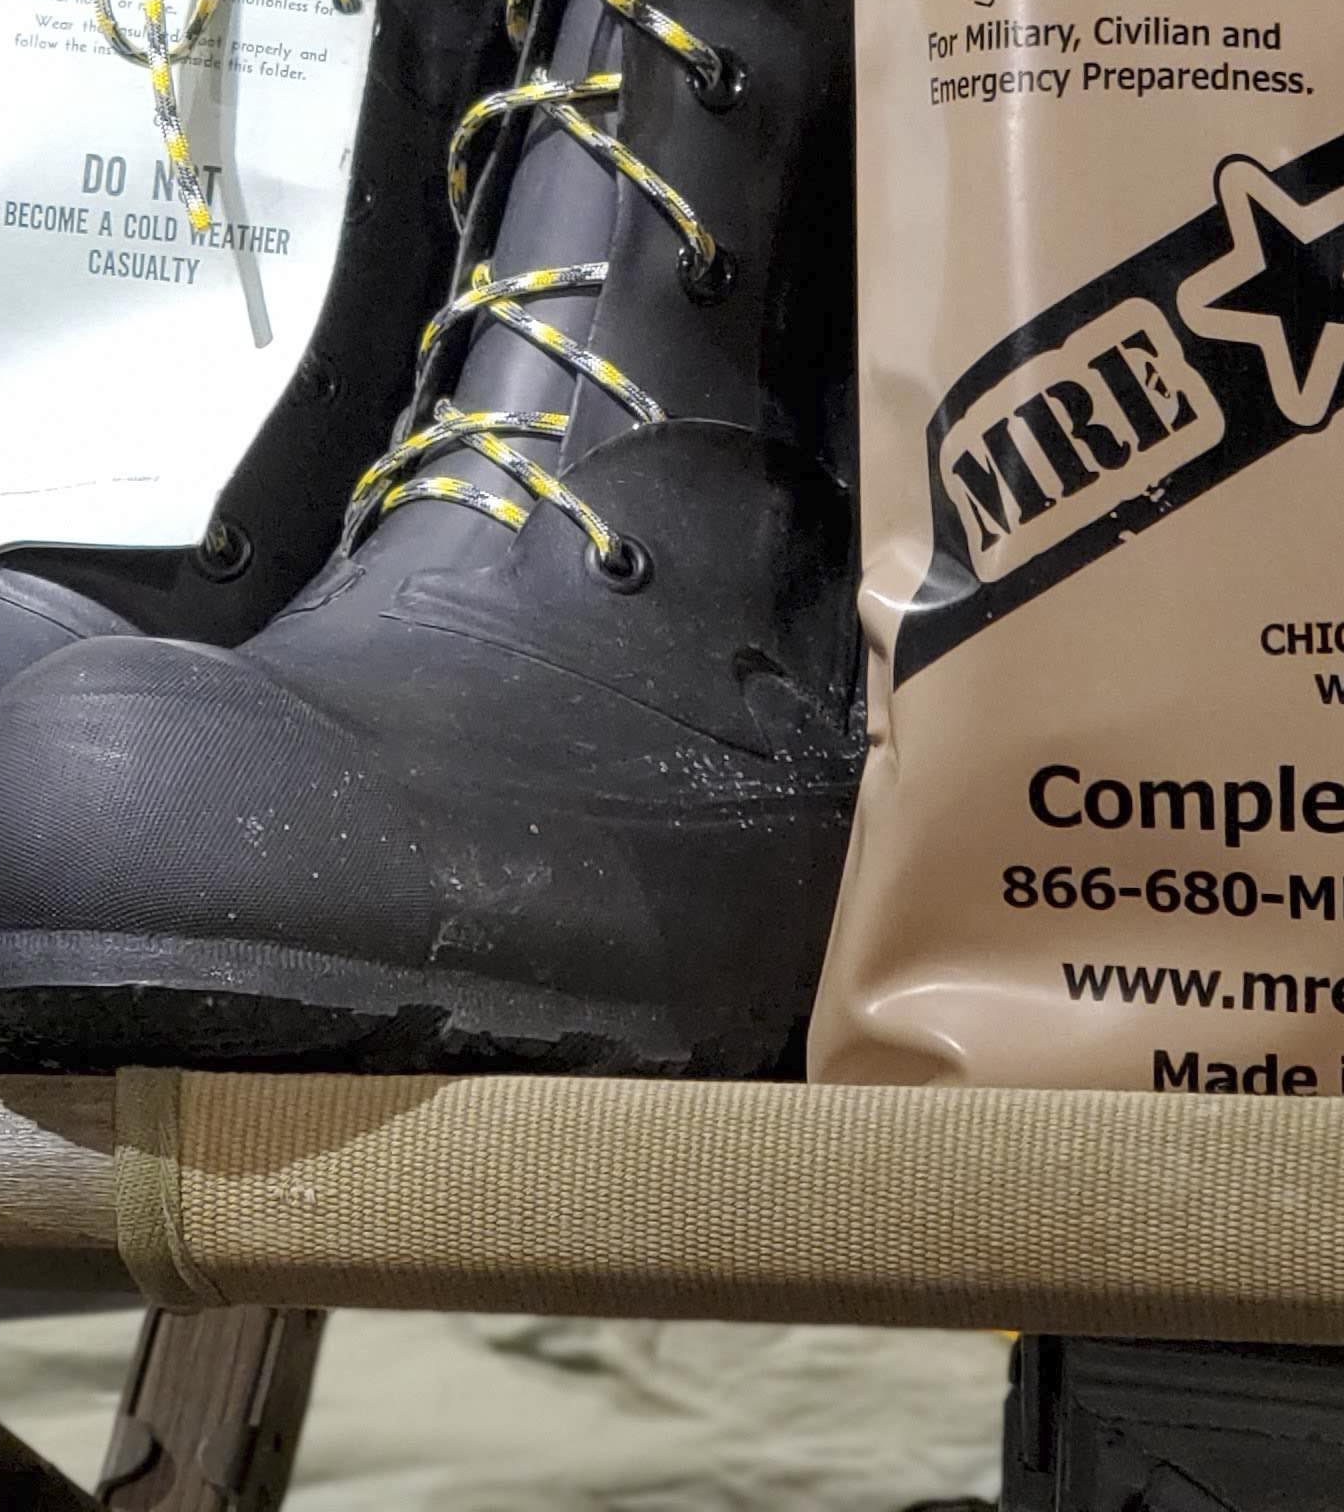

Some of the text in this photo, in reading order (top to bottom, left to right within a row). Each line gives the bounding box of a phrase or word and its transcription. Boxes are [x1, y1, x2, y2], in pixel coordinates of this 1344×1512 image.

[314, 1, 335, 16] for
[14, 34, 58, 50] follow
[65, 37, 87, 53] the
[259, 61, 307, 81] folder.
[35, 14, 73, 31] Wear
[231, 40, 293, 61] properly
[299, 49, 328, 63] and
[927, 16, 1282, 62] For Military, Civilian and
[929, 61, 1315, 106] Emergency Preparedness.
[82, 153, 223, 206] DO NT
[4, 200, 89, 235] BECOME
[98, 211, 112, 237] A
[124, 213, 178, 242] COLD
[89, 249, 201, 285] CASUALTY
[952, 328, 1199, 552] MRE
[1153, 1049, 1319, 1096] Made
